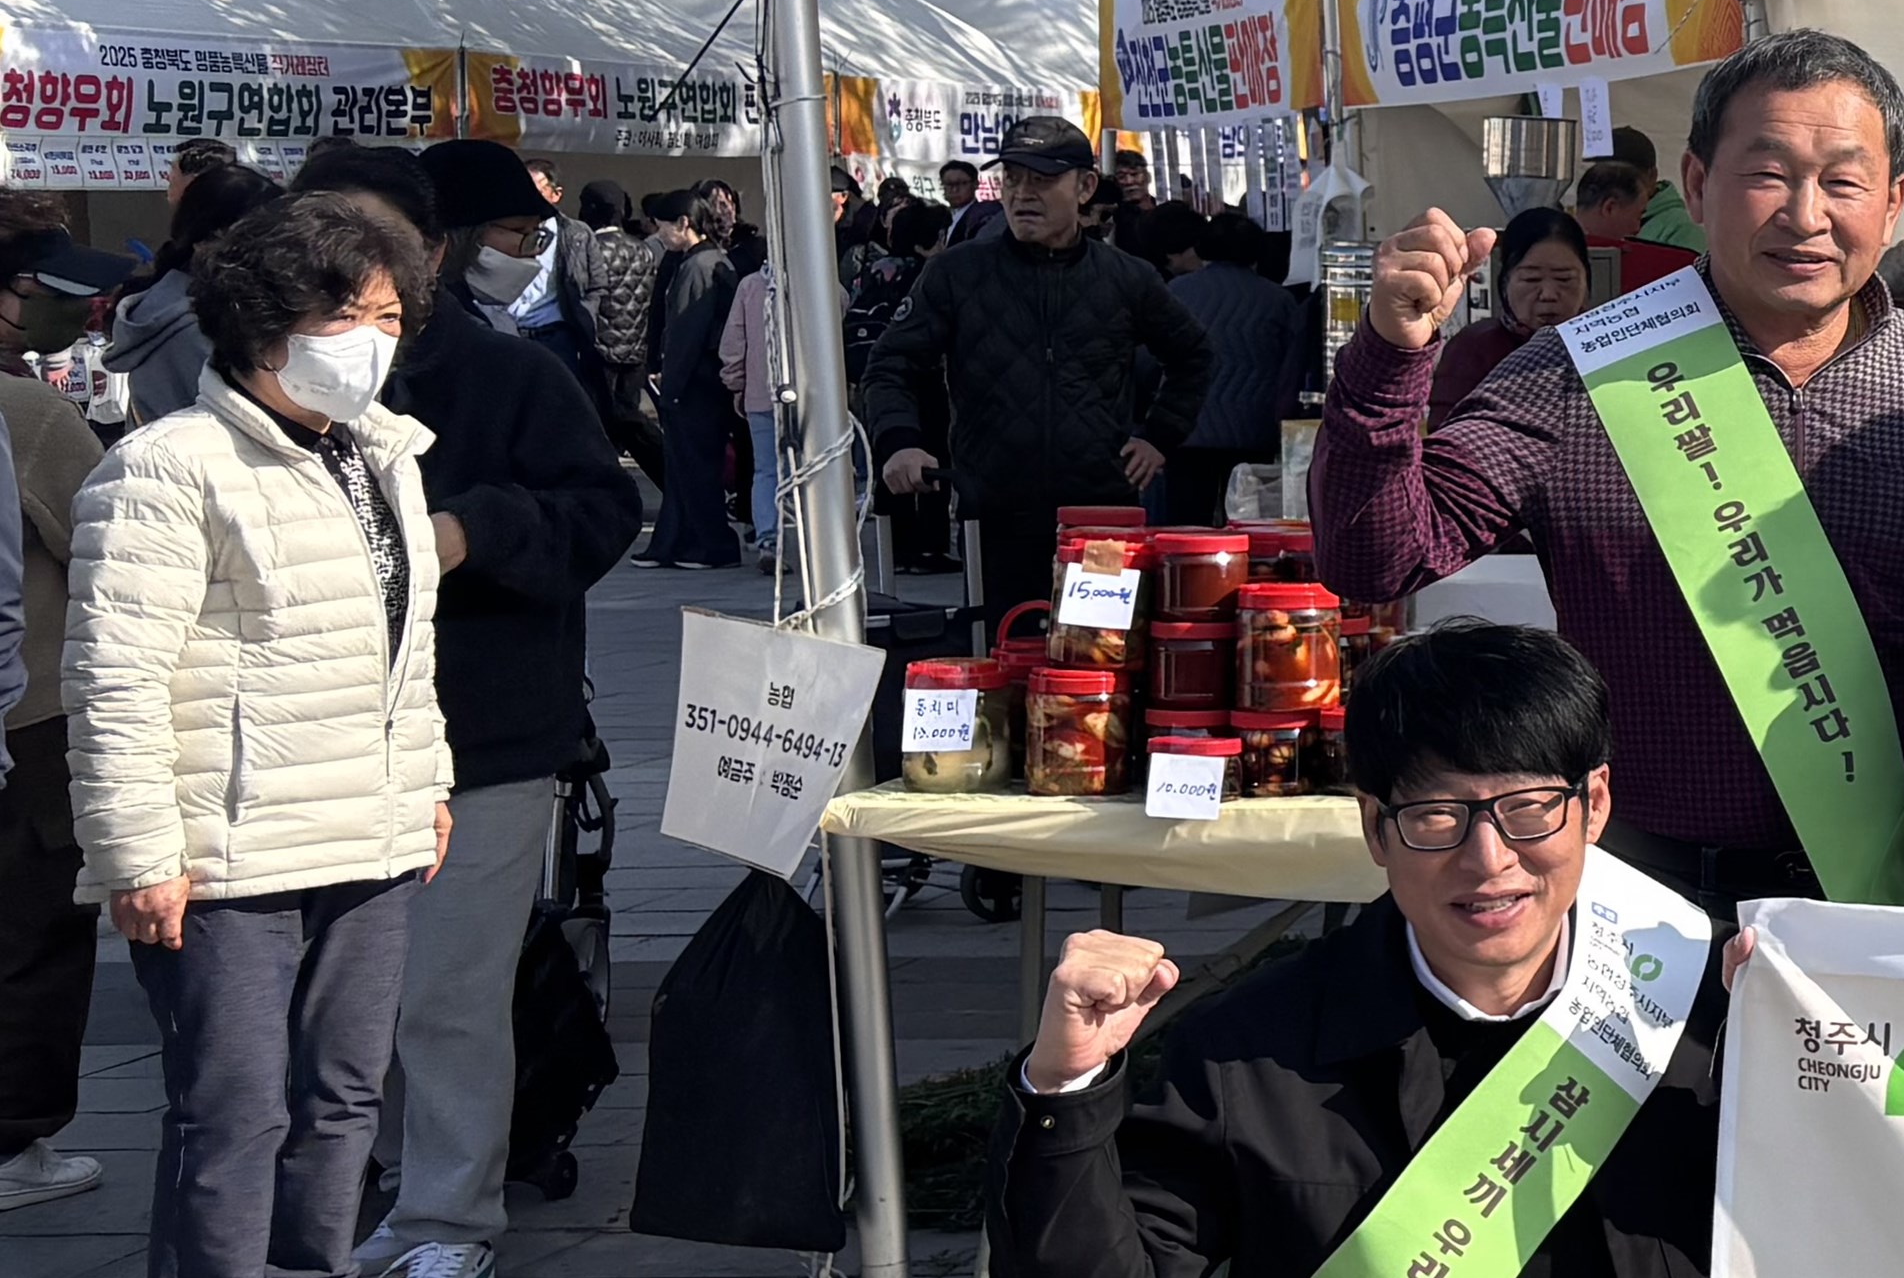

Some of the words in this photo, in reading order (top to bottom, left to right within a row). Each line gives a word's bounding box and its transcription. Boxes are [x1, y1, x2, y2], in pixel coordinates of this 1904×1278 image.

[100, 45, 138, 68] 2025
[140, 48, 192, 72] 충청북도
[142, 78, 321, 139] 노원구연합회
[491, 65, 608, 119] 충청향우회
[1581, 302, 1701, 353] 농업인단체협의회
[1646, 361, 1723, 491] 우리쌀!
[1713, 500, 1785, 603] 우리가
[1761, 606, 1855, 783] 먹읍시다!
[768, 682, 795, 709] 농협
[685, 704, 847, 768] 351-0944-6494-13
[717, 756, 755, 785] 예금주
[1794, 1014, 1894, 1058] 청주시
[1797, 1057, 1881, 1084] CHEONGJU
[1798, 1075, 1831, 1093] CITY
[1463, 1076, 1591, 1219] 삼시세끼
